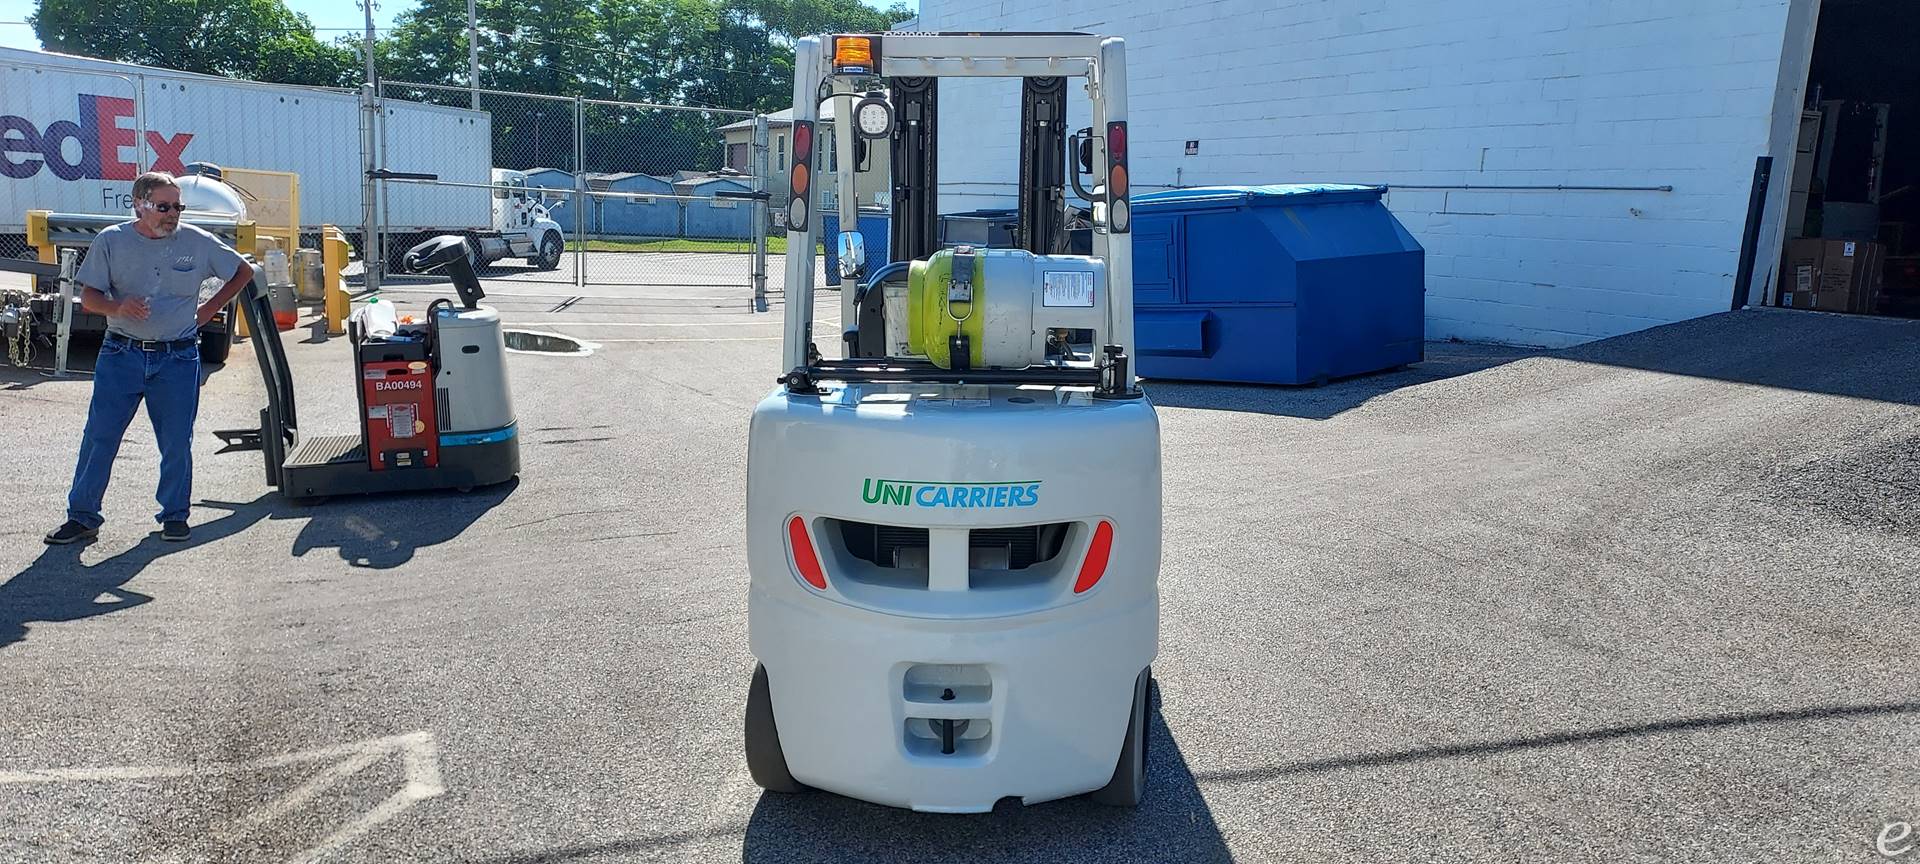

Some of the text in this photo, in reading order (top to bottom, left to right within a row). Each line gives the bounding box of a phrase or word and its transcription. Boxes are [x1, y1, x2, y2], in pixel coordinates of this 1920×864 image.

[0, 93, 194, 181] edEx
[103, 187, 134, 209] Fre
[375, 380, 422, 391] BA00494
